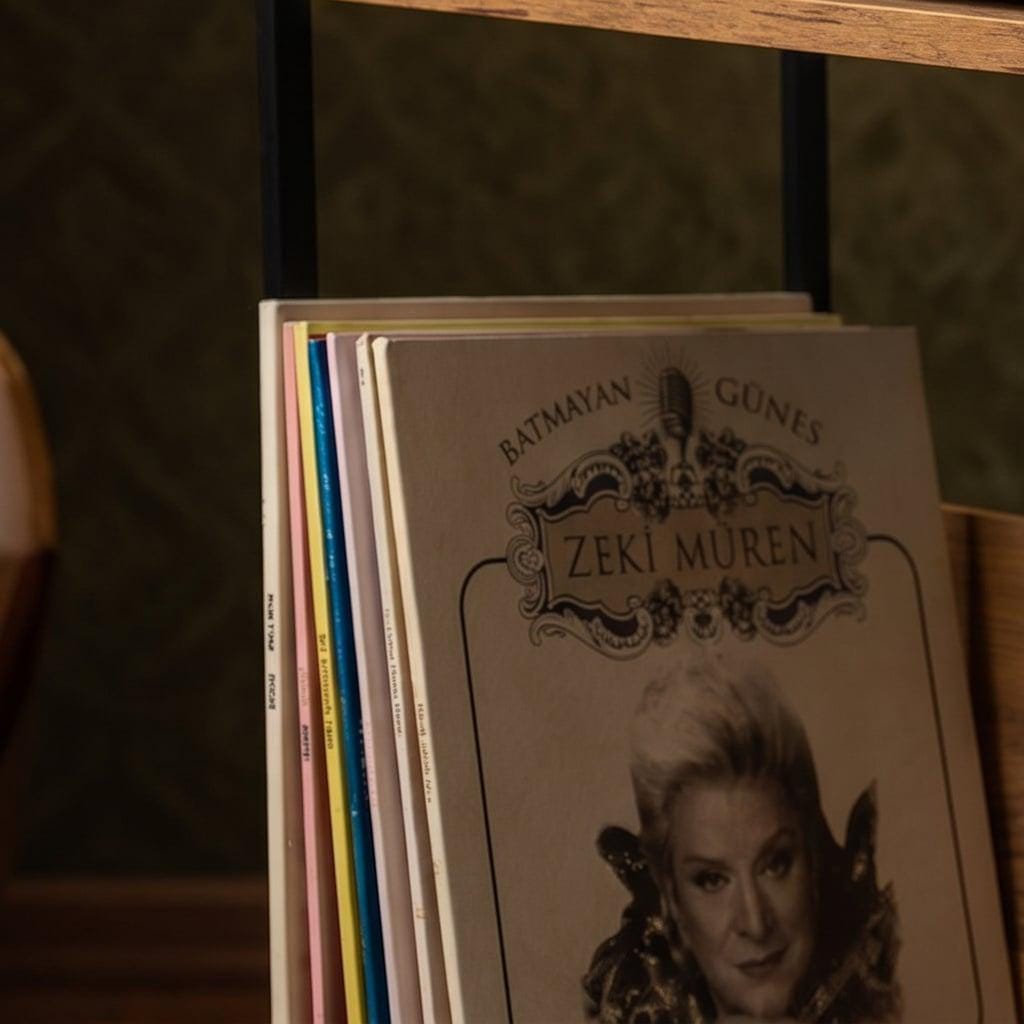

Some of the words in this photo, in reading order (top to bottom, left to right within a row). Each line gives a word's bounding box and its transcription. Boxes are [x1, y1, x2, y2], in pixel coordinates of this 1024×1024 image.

[498, 375, 632, 466] BATMAYAN
[563, 524, 658, 578] ZEKİ
[674, 521, 819, 573] MÜREN
